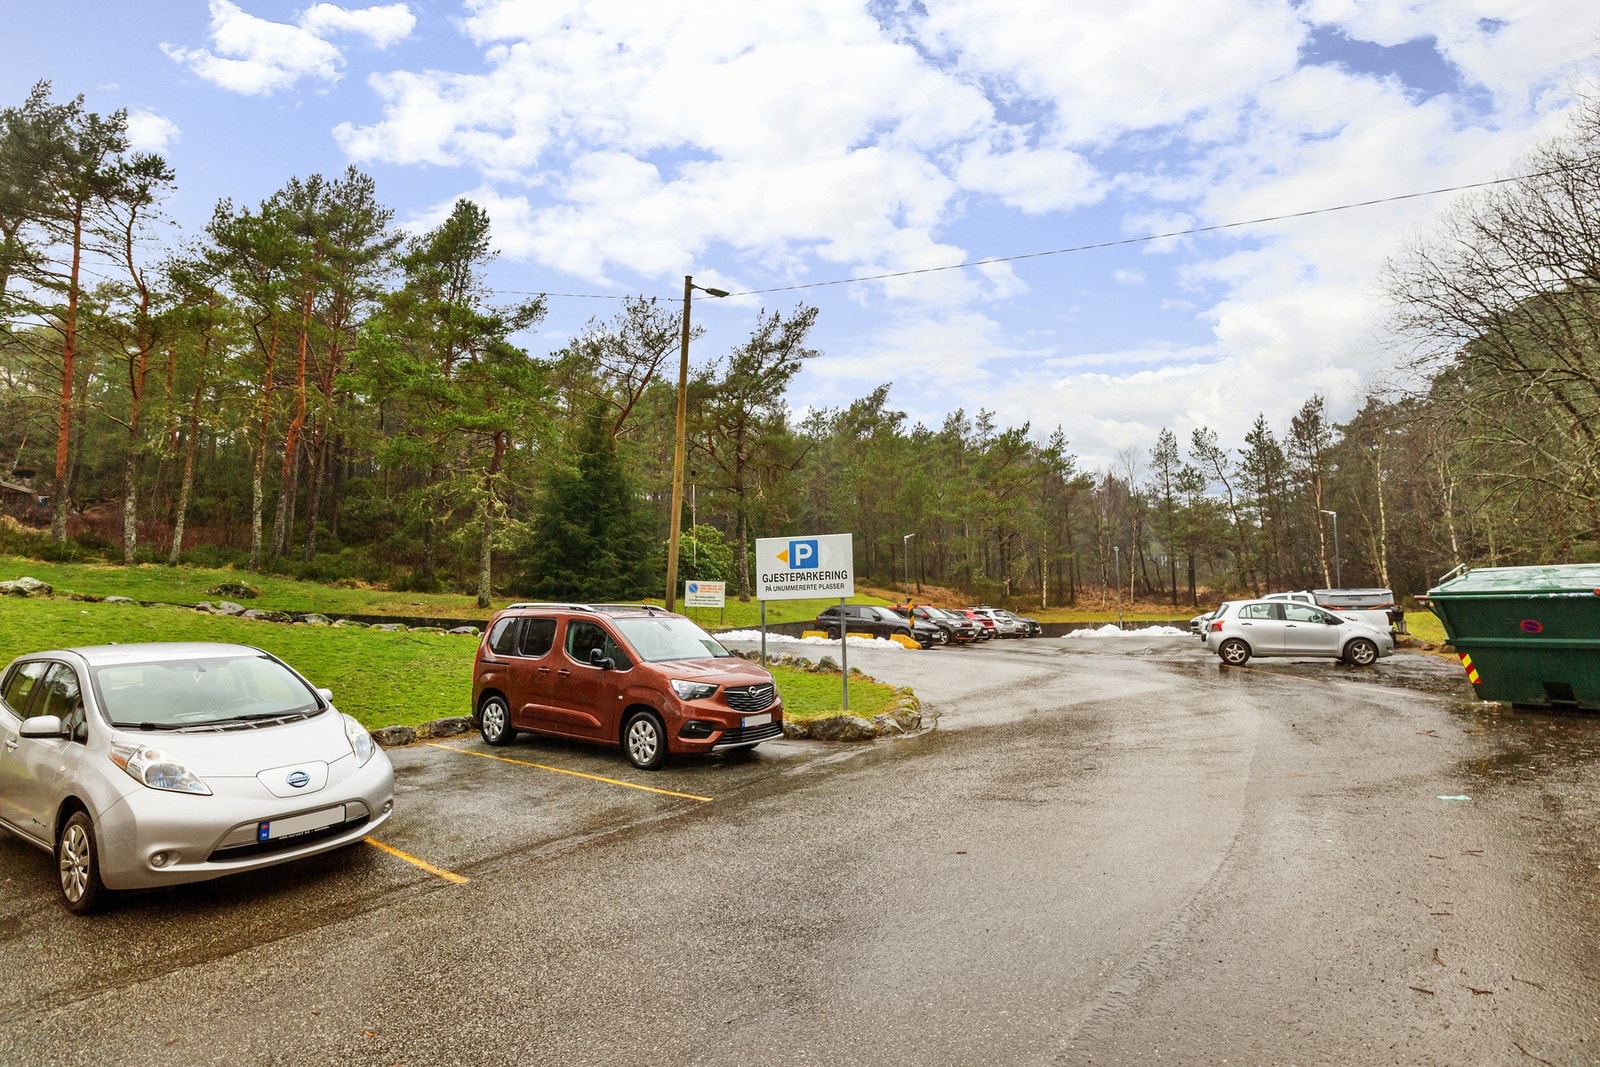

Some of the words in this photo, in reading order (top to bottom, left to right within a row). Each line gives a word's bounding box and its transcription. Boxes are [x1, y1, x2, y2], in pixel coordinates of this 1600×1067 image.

[795, 543, 813, 566] P
[762, 570, 848, 583] GJESTEPARKERING
[773, 584, 817, 592] UNUMMERERTE
